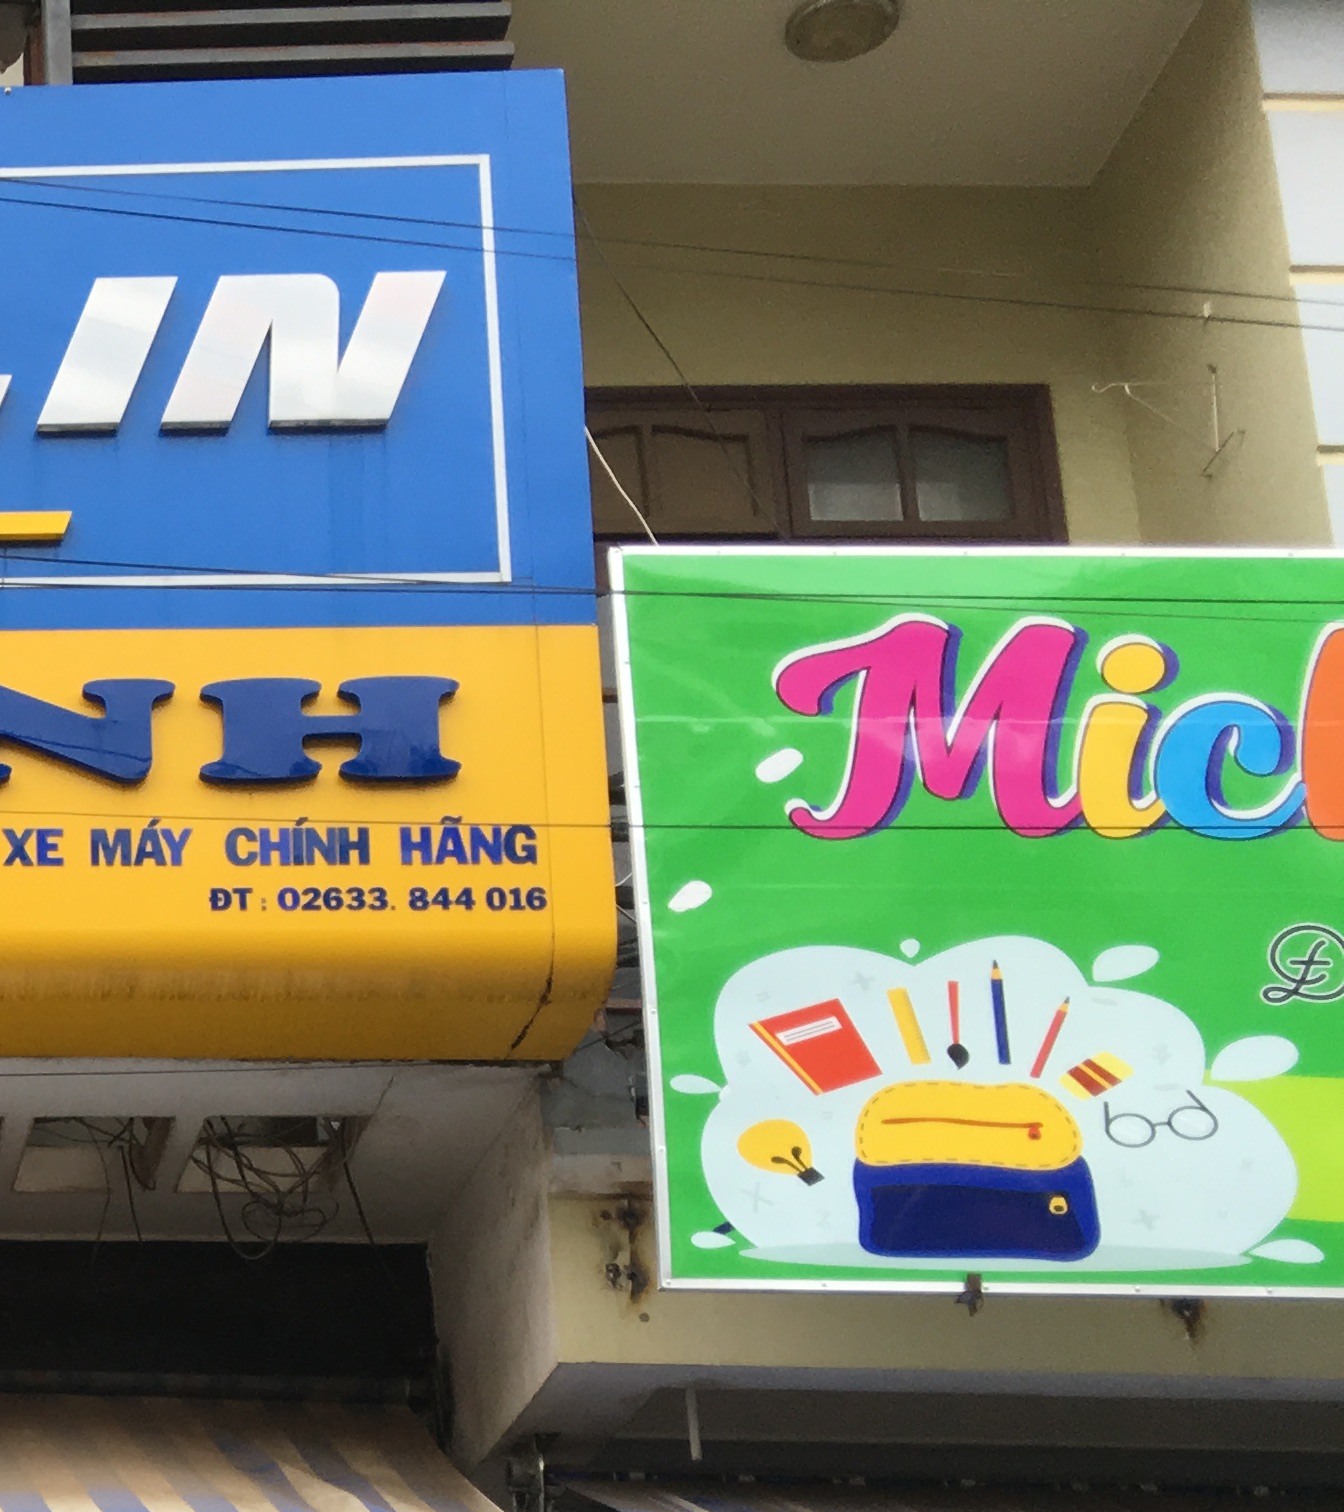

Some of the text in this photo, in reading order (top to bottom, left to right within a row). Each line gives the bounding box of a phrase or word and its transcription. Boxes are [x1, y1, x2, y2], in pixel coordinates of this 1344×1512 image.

[2, 828, 65, 867] XE
[90, 817, 194, 867] MÁY
[224, 816, 371, 867] CHÍNH
[399, 814, 538, 865] HÃNG
[408, 886, 476, 911] 844
[486, 886, 548, 911] 016
